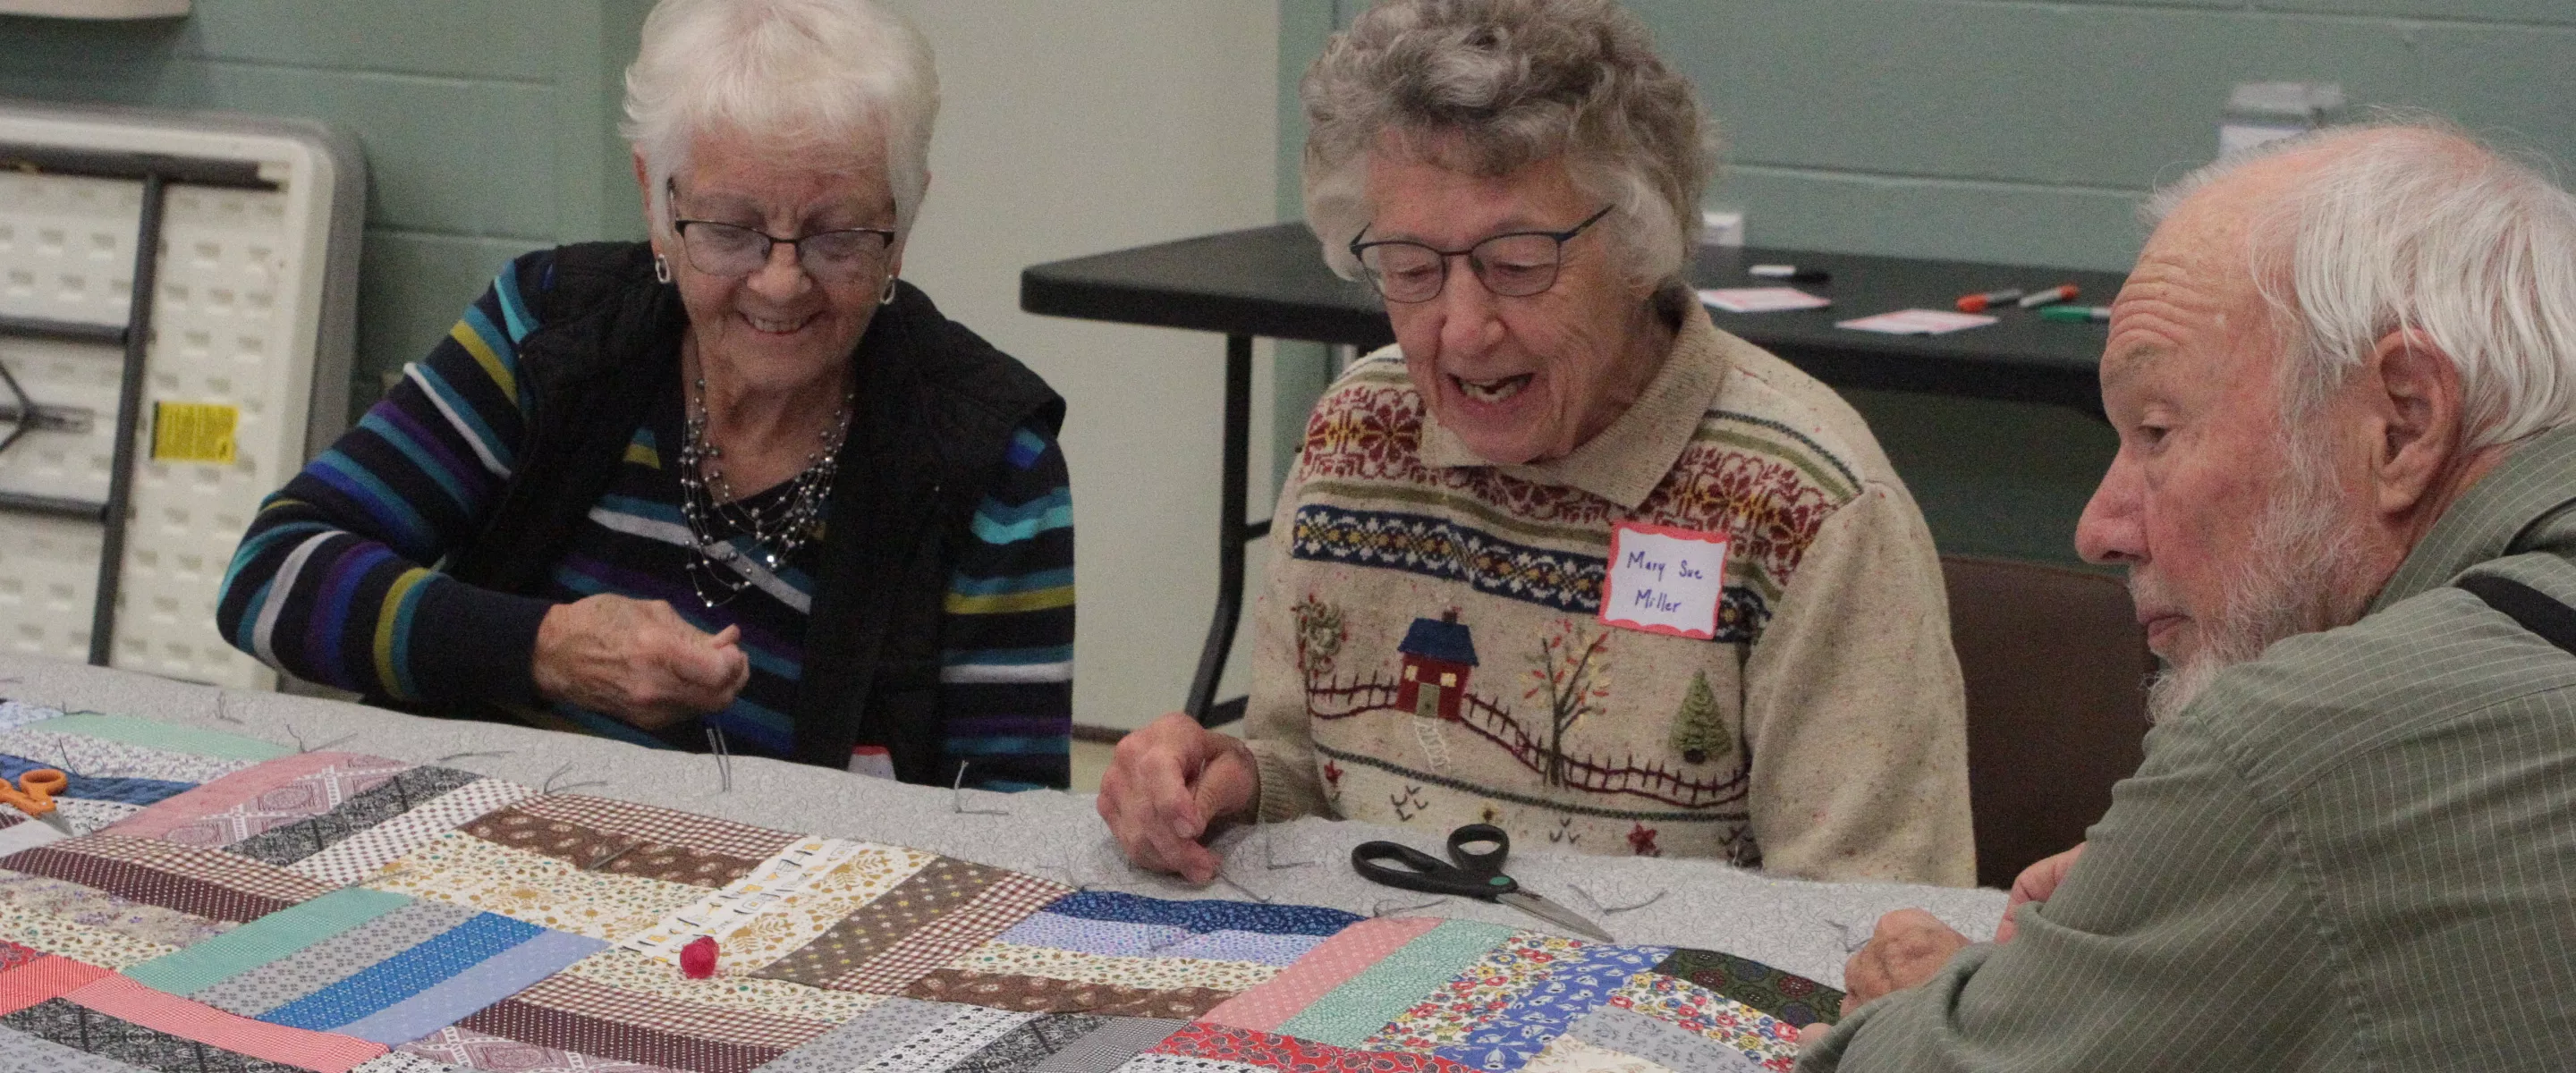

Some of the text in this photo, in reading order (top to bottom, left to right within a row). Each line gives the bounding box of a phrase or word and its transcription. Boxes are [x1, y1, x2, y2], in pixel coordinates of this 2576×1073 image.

[1627, 551, 1702, 581] Mary Sue
[1635, 589, 1682, 613] Miller
